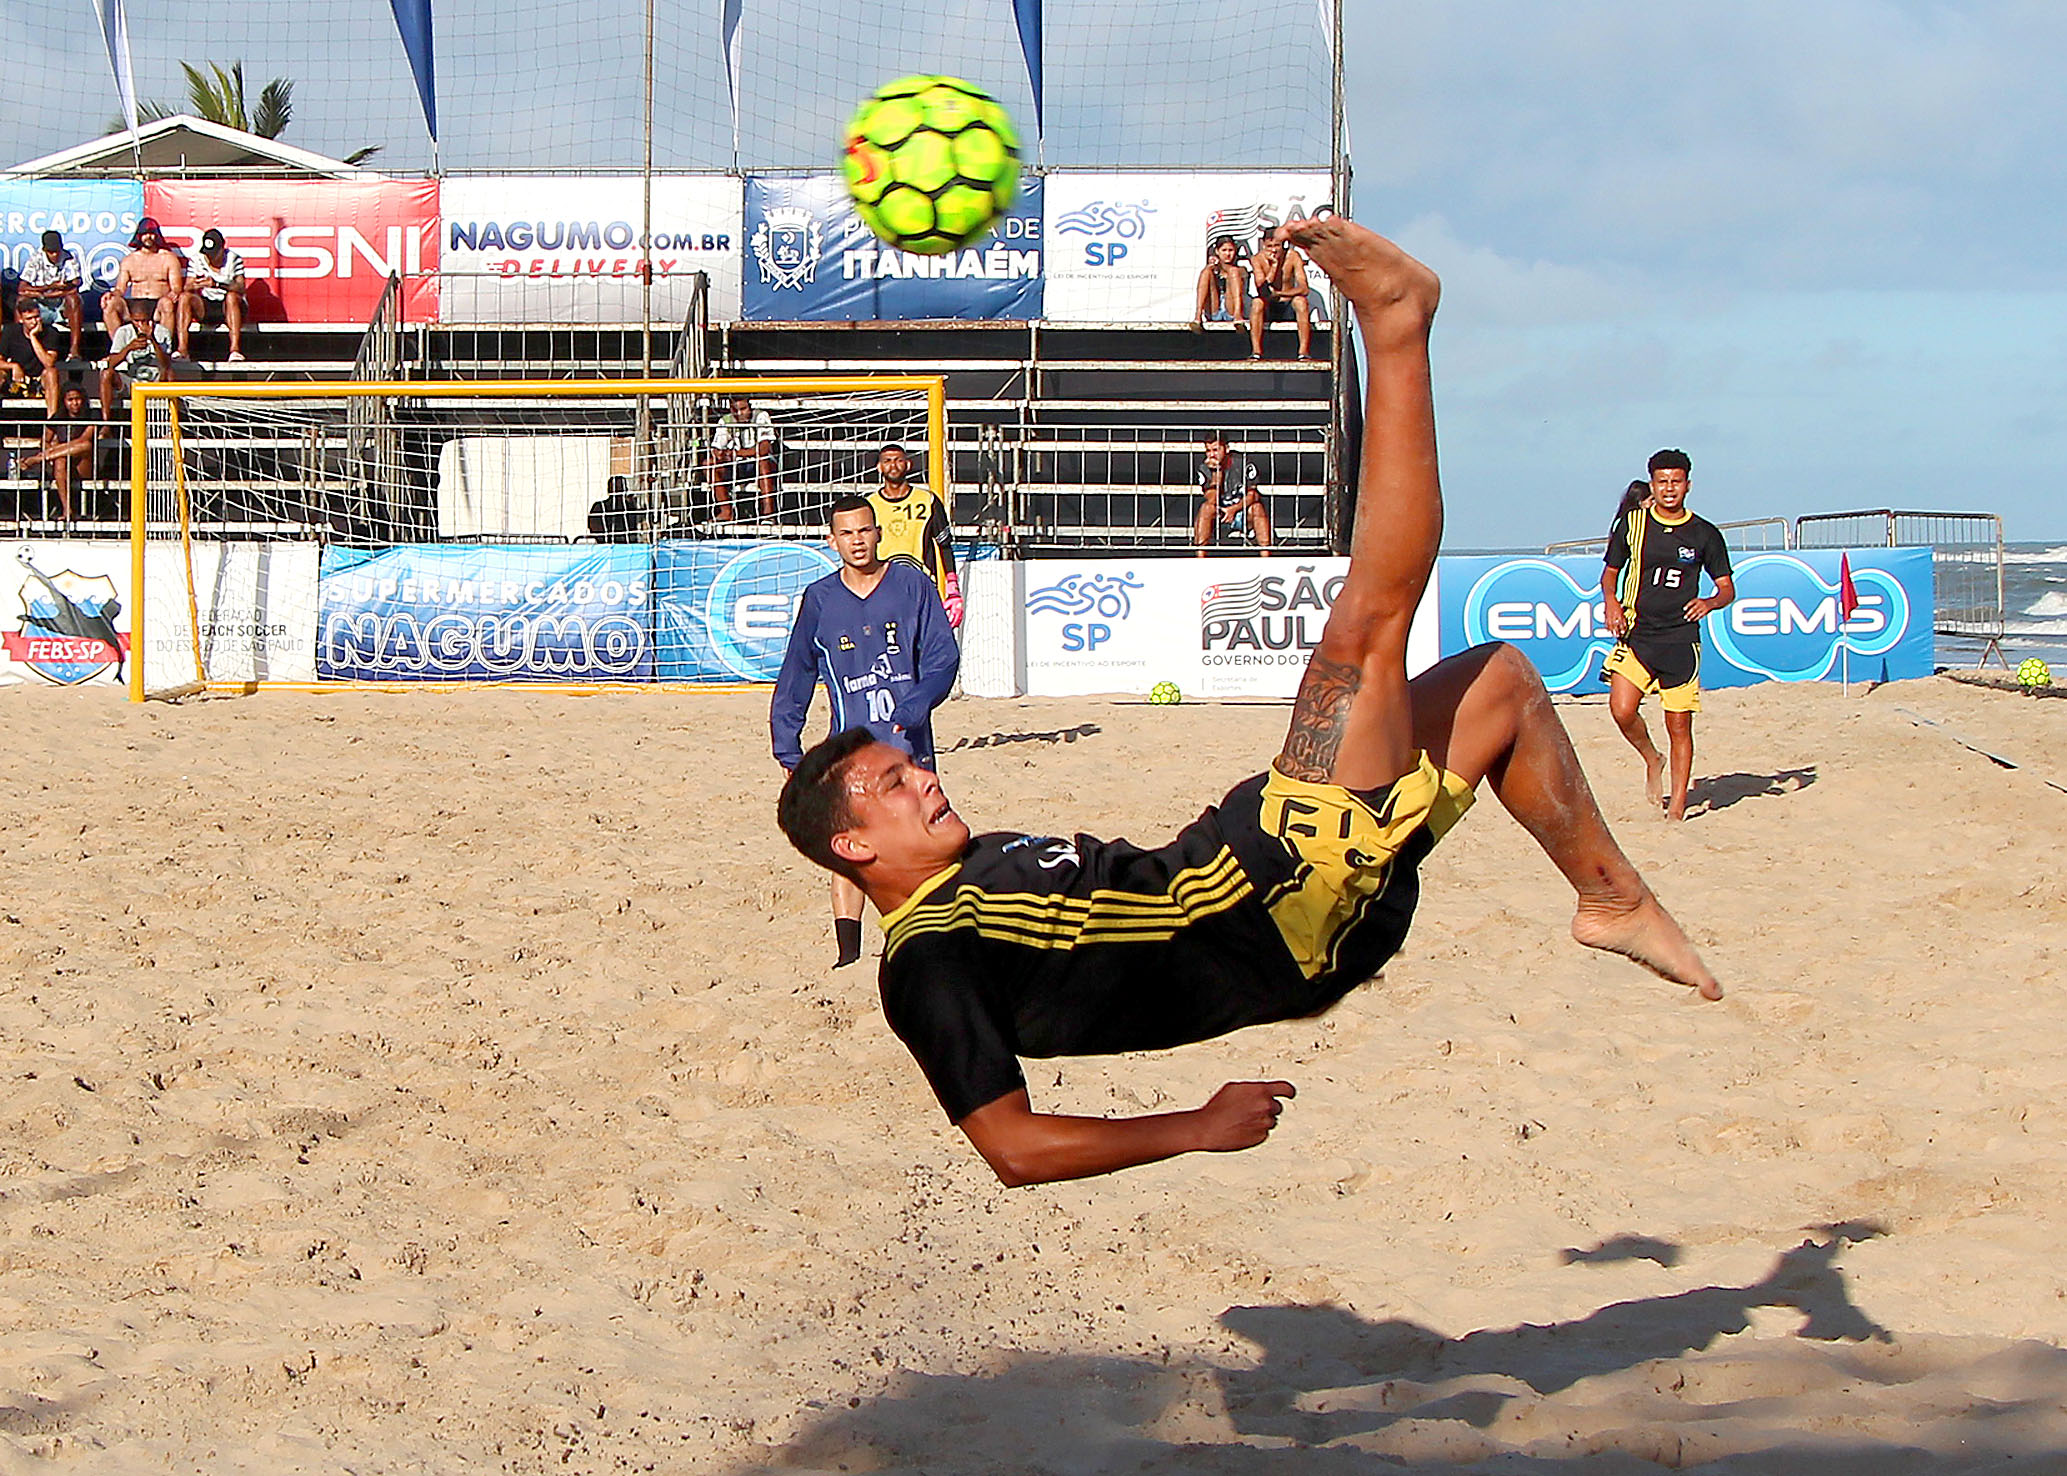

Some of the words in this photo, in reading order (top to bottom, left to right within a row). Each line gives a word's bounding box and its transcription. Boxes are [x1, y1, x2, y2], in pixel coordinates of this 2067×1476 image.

[0, 211, 137, 235] RCADOS
[843, 241, 1039, 279] ITANHAÉM
[1084, 242, 1128, 267] SP
[500, 258, 677, 278] DELIVERY
[903, 503, 927, 520] 12
[1653, 567, 1682, 588] 15
[327, 579, 648, 605] SUPERMERCADOS
[188, 609, 262, 622] EDERAÇÃO
[1731, 597, 1885, 635] EMS
[237, 625, 287, 636] SOCCER
[1062, 623, 1111, 651] SP
[1202, 616, 1326, 650] PAUL
[28, 640, 105, 661] FEBS-SP
[326, 613, 645, 673] NAGUMO
[1202, 655, 1274, 665] GOVERNO
[1278, 655, 1299, 665] DO
[866, 688, 895, 723] 10
